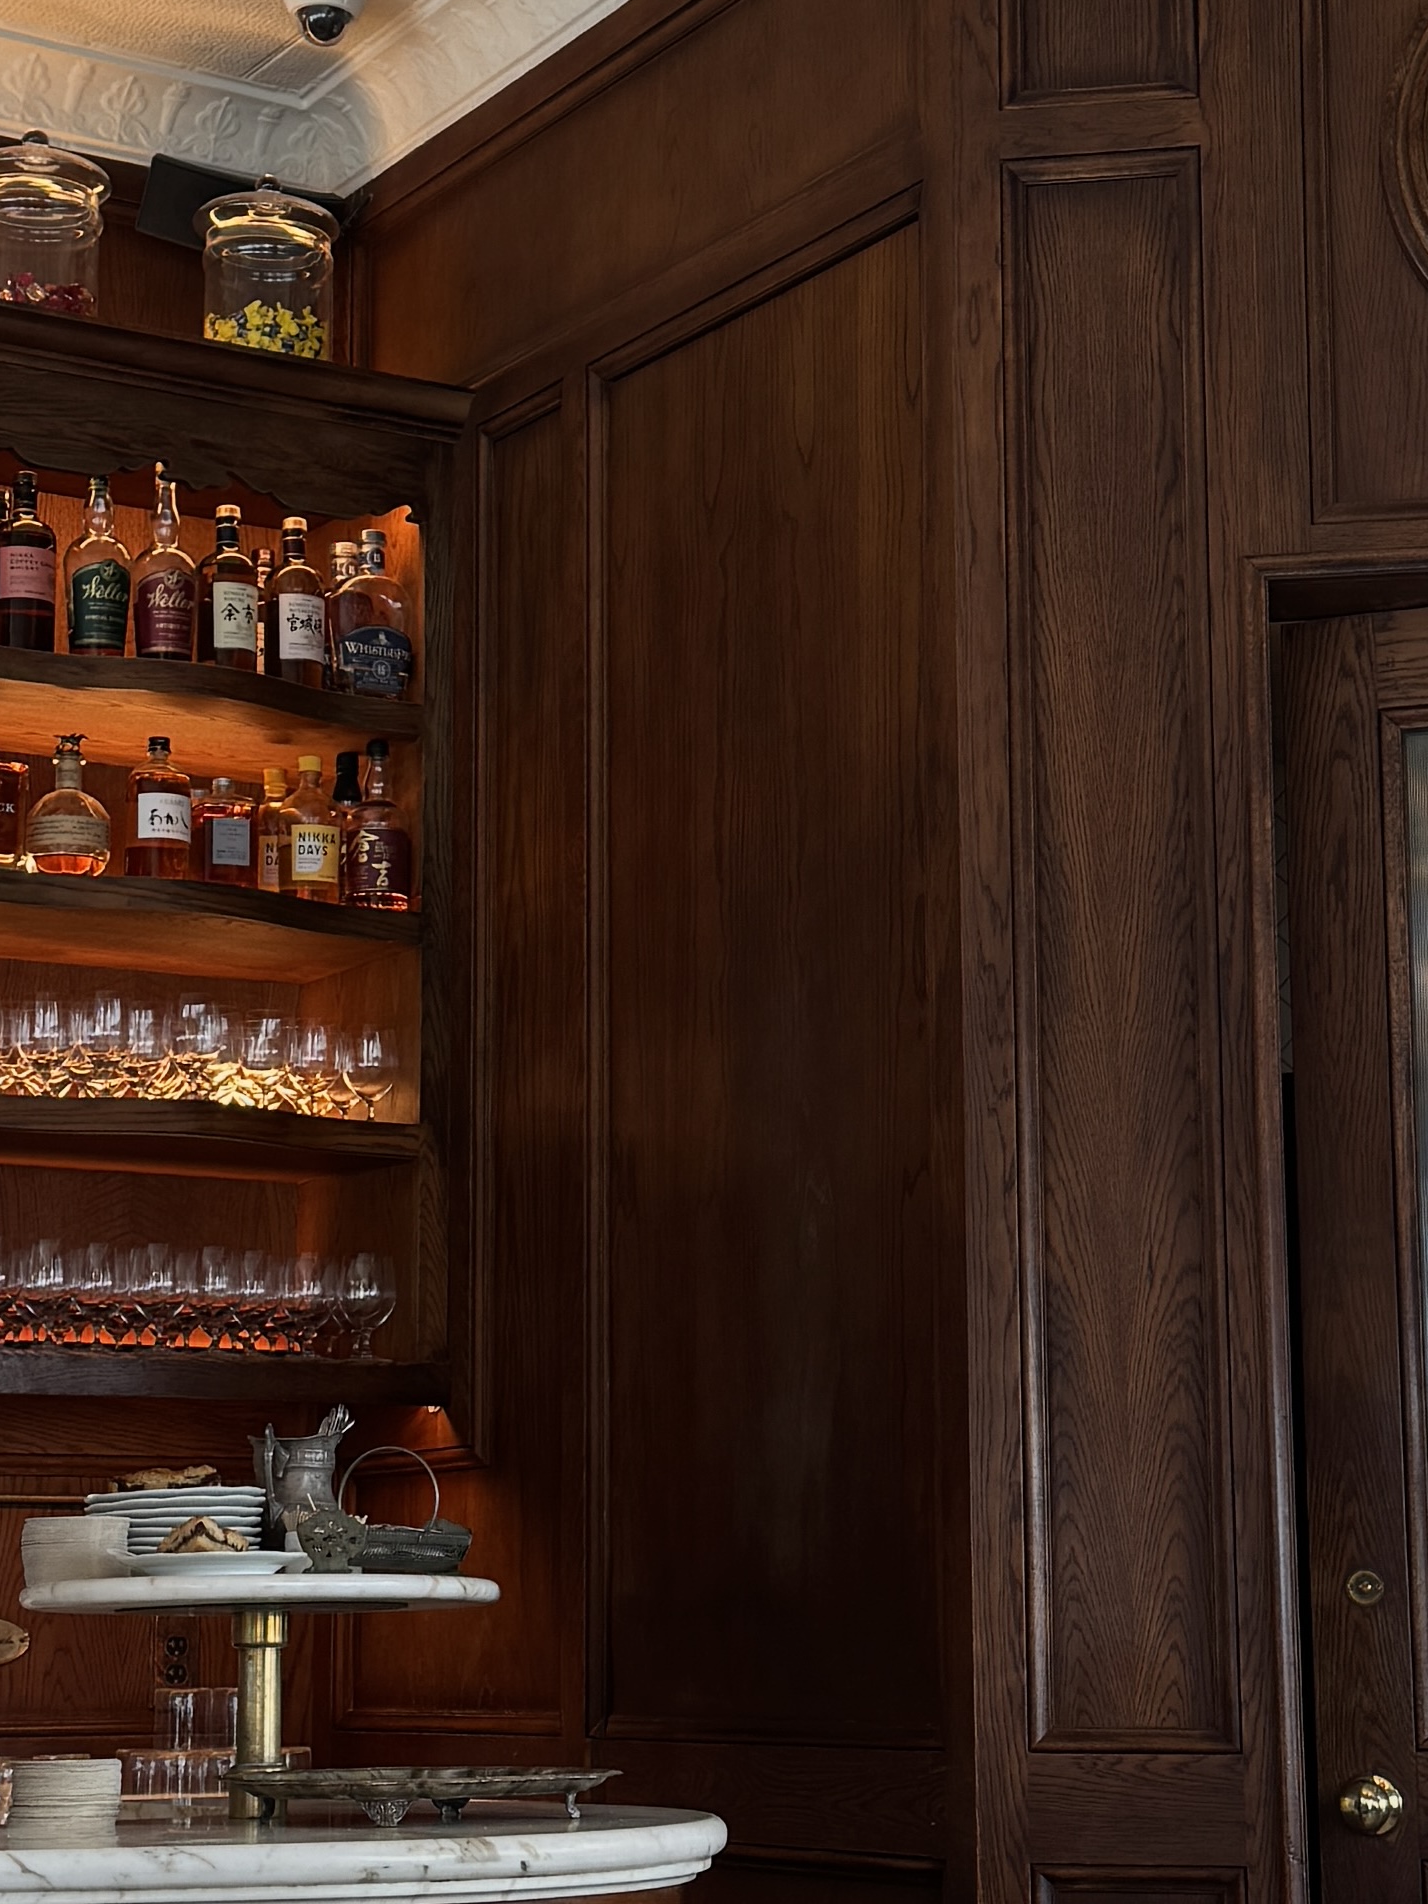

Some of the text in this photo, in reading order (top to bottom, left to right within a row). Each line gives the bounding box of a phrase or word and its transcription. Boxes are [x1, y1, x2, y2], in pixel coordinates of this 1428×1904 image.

[82, 575, 128, 603] Weller
[147, 583, 195, 610] Weller
[297, 831, 337, 845] NIKKA
[298, 844, 328, 857] DAYS
